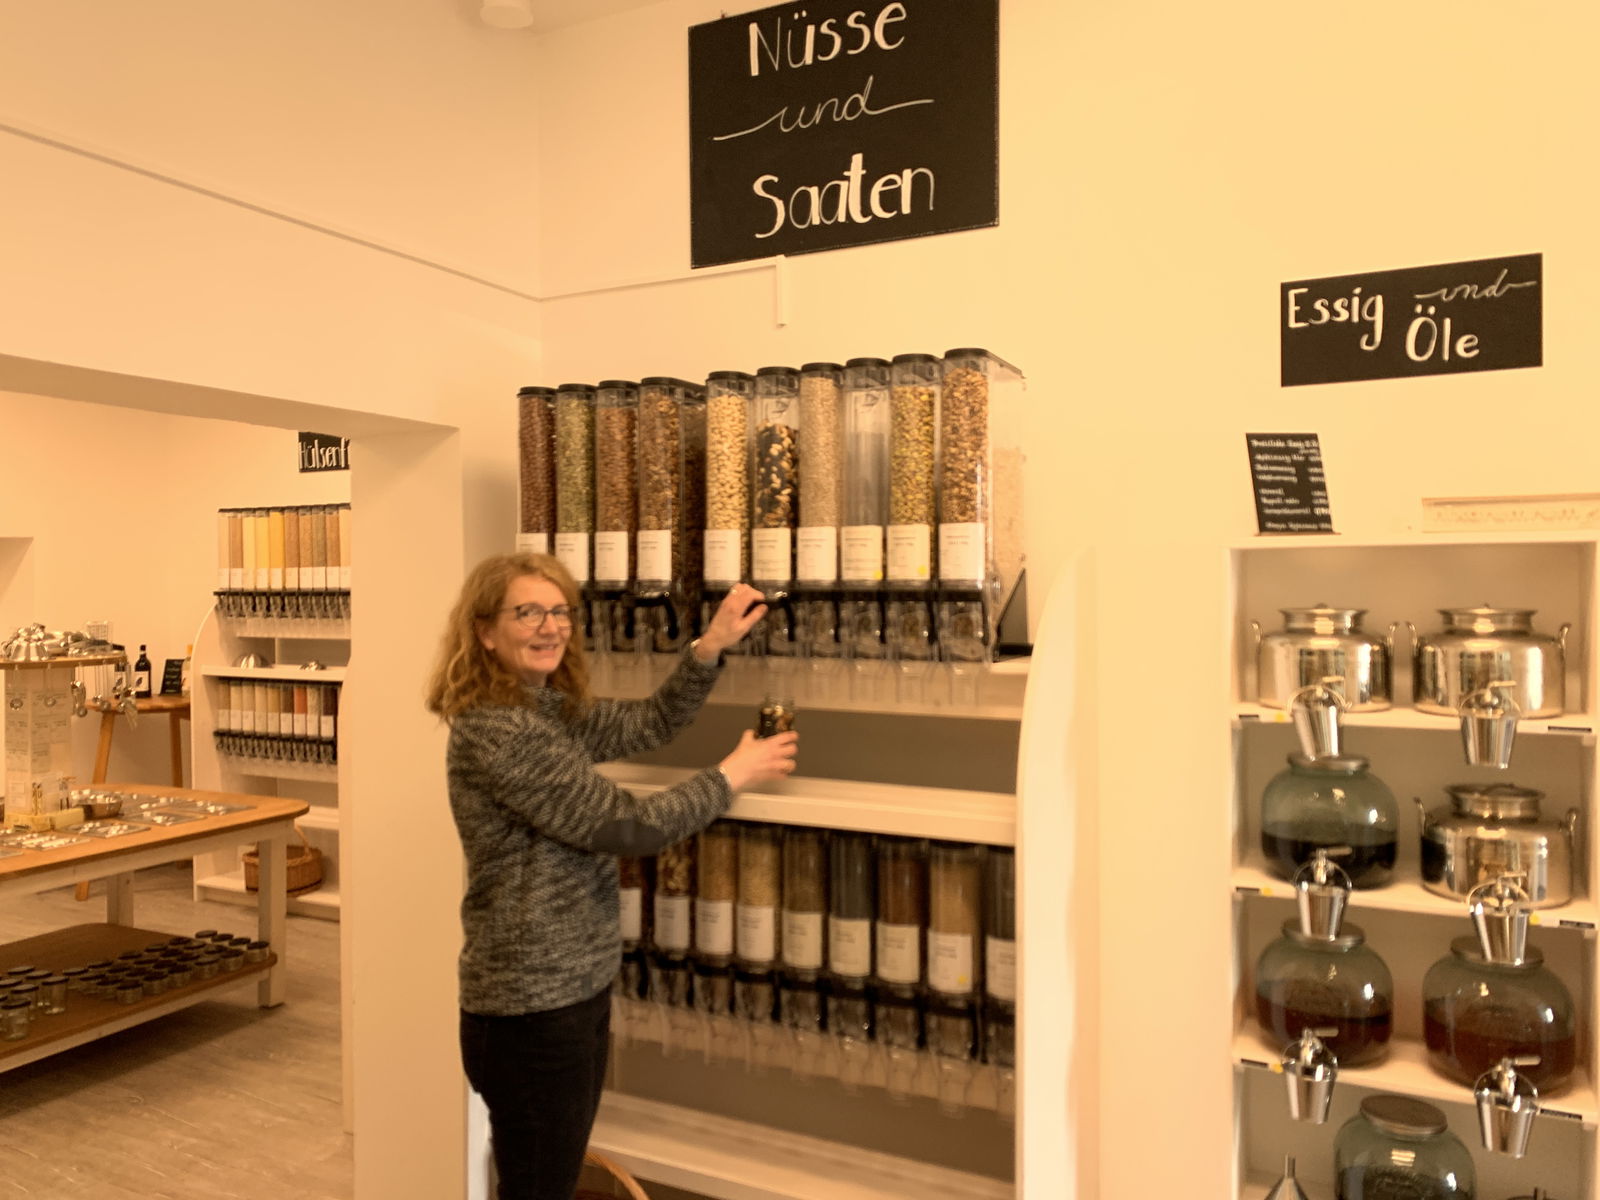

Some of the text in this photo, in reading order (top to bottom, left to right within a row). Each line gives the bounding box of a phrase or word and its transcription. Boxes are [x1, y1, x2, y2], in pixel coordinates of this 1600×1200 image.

[749, 2, 907, 77] Nüsse
[712, 75, 935, 141] und
[753, 153, 935, 239] Saaten
[1288, 268, 1538, 351] Essig und
[1405, 304, 1480, 362] Öle
[299, 437, 350, 469] Hülsenf
